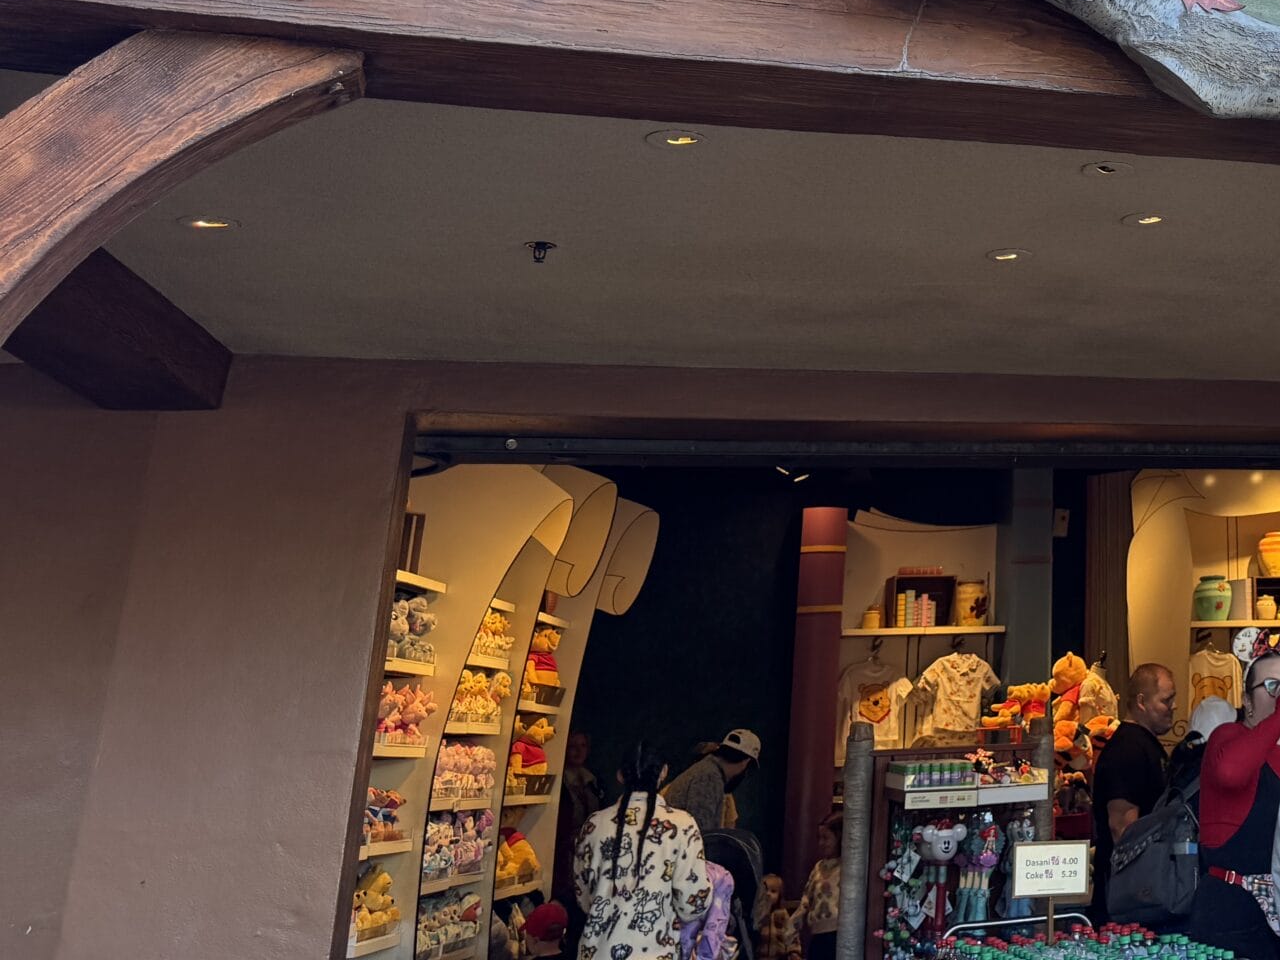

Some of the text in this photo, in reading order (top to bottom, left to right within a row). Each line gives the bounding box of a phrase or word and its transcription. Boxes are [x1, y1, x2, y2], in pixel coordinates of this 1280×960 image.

[1025, 858, 1050, 867] Dasani
[1061, 857, 1078, 865] 4.00
[1025, 871, 1043, 880] Coke
[1061, 870, 1078, 878] 5.29
